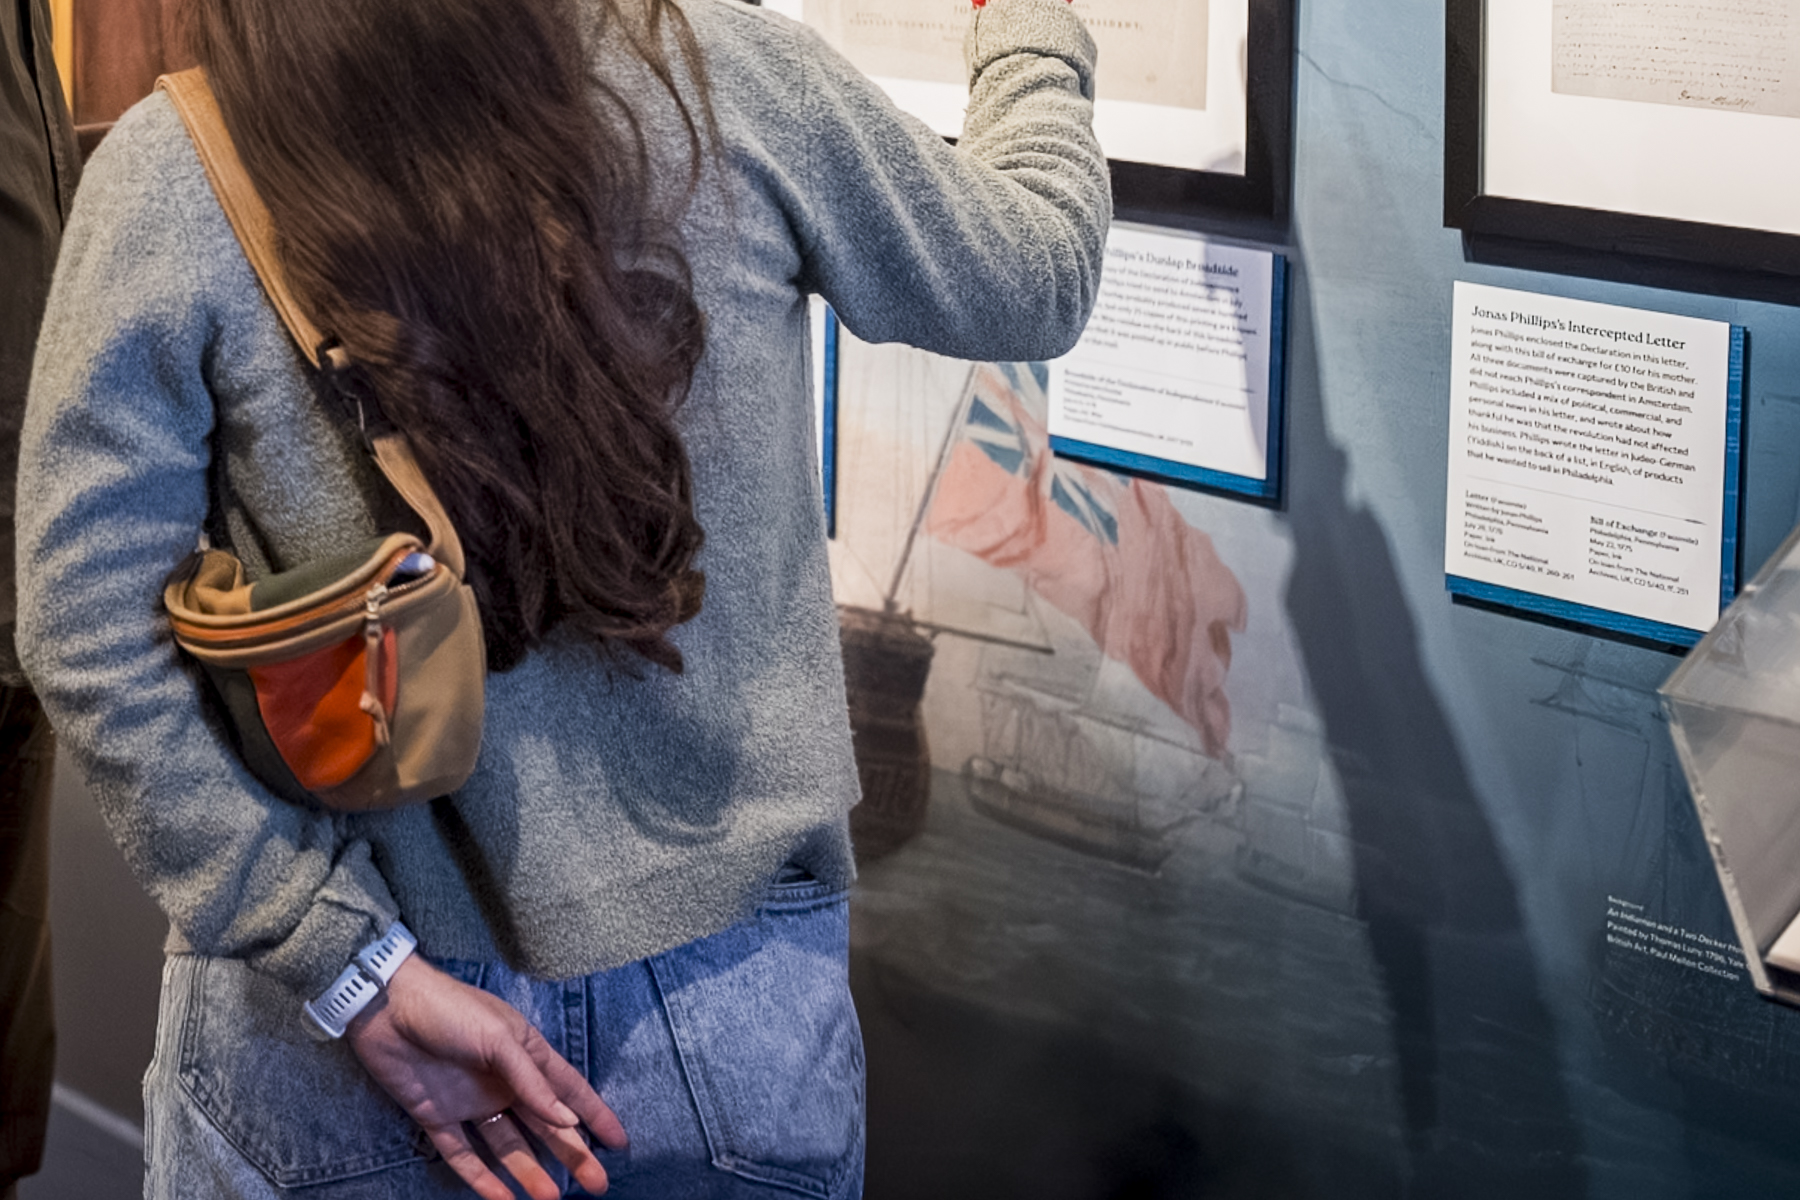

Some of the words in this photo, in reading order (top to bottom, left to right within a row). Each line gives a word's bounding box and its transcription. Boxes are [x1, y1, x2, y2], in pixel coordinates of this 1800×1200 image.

[1471, 326, 1492, 335] Jonas
[1494, 329, 1523, 341] Phillips
[1526, 336, 1563, 347] enclosed
[1565, 341, 1578, 349] the
[1580, 343, 1631, 357] Declaration
[1643, 354, 1659, 363] this
[1472, 306, 1507, 320] Jonas
[1511, 312, 1565, 329] Phillips's
[1568, 321, 1642, 342] Intercepted
[1646, 333, 1685, 348] Letter
[1471, 340, 1492, 351] along
[1515, 347, 1530, 356] this
[1532, 349, 1544, 357] bill
[1557, 356, 1597, 368] exchange
[1599, 360, 1612, 369] for
[1614, 363, 1630, 373] £10
[1632, 366, 1645, 375] for
[1647, 369, 1660, 378] his
[1482, 356, 1503, 365] three
[1506, 360, 1552, 373] documents
[1577, 373, 1615, 385] captured
[1617, 378, 1627, 388] by
[1630, 381, 1644, 390] the
[1646, 383, 1676, 394] British
[1678, 390, 1694, 398] and
[1469, 381, 1498, 392] Phillips
[1500, 388, 1535, 398] included
[1665, 417, 1682, 425] and
[1499, 374, 1522, 382] reach
[1524, 376, 1560, 389] Phillips's
[1562, 385, 1625, 400] correspondent
[1468, 396, 1503, 406] personal
[1505, 403, 1526, 411] news
[1538, 407, 1549, 415] his
[1579, 416, 1595, 424] and
[1597, 420, 1622, 428] wrote
[1624, 424, 1649, 433] about
[1652, 427, 1671, 438] how
[1468, 409, 1502, 420] thankful
[1534, 420, 1550, 429] that
[1553, 424, 1567, 433] the
[1569, 429, 1613, 441] revolution
[1615, 435, 1631, 445] had
[1633, 440, 1647, 448] not
[1650, 443, 1688, 455] affected
[1467, 436, 1504, 448] (Yiddish)
[1518, 446, 1532, 454] the
[1534, 449, 1553, 458] back
[1644, 471, 1683, 483] products
[1467, 449, 1483, 458] that
[1496, 457, 1526, 467] wanted
[1528, 461, 1537, 469] to
[1538, 464, 1551, 472] sell
[1468, 422, 1478, 430] his
[1520, 431, 1549, 444] Phillips
[1552, 440, 1576, 448] wrote
[1579, 443, 1592, 452] the
[1595, 446, 1618, 456] letter
[1630, 453, 1695, 470] Judeo-German
[1697, 962, 1738, 979] Collection
